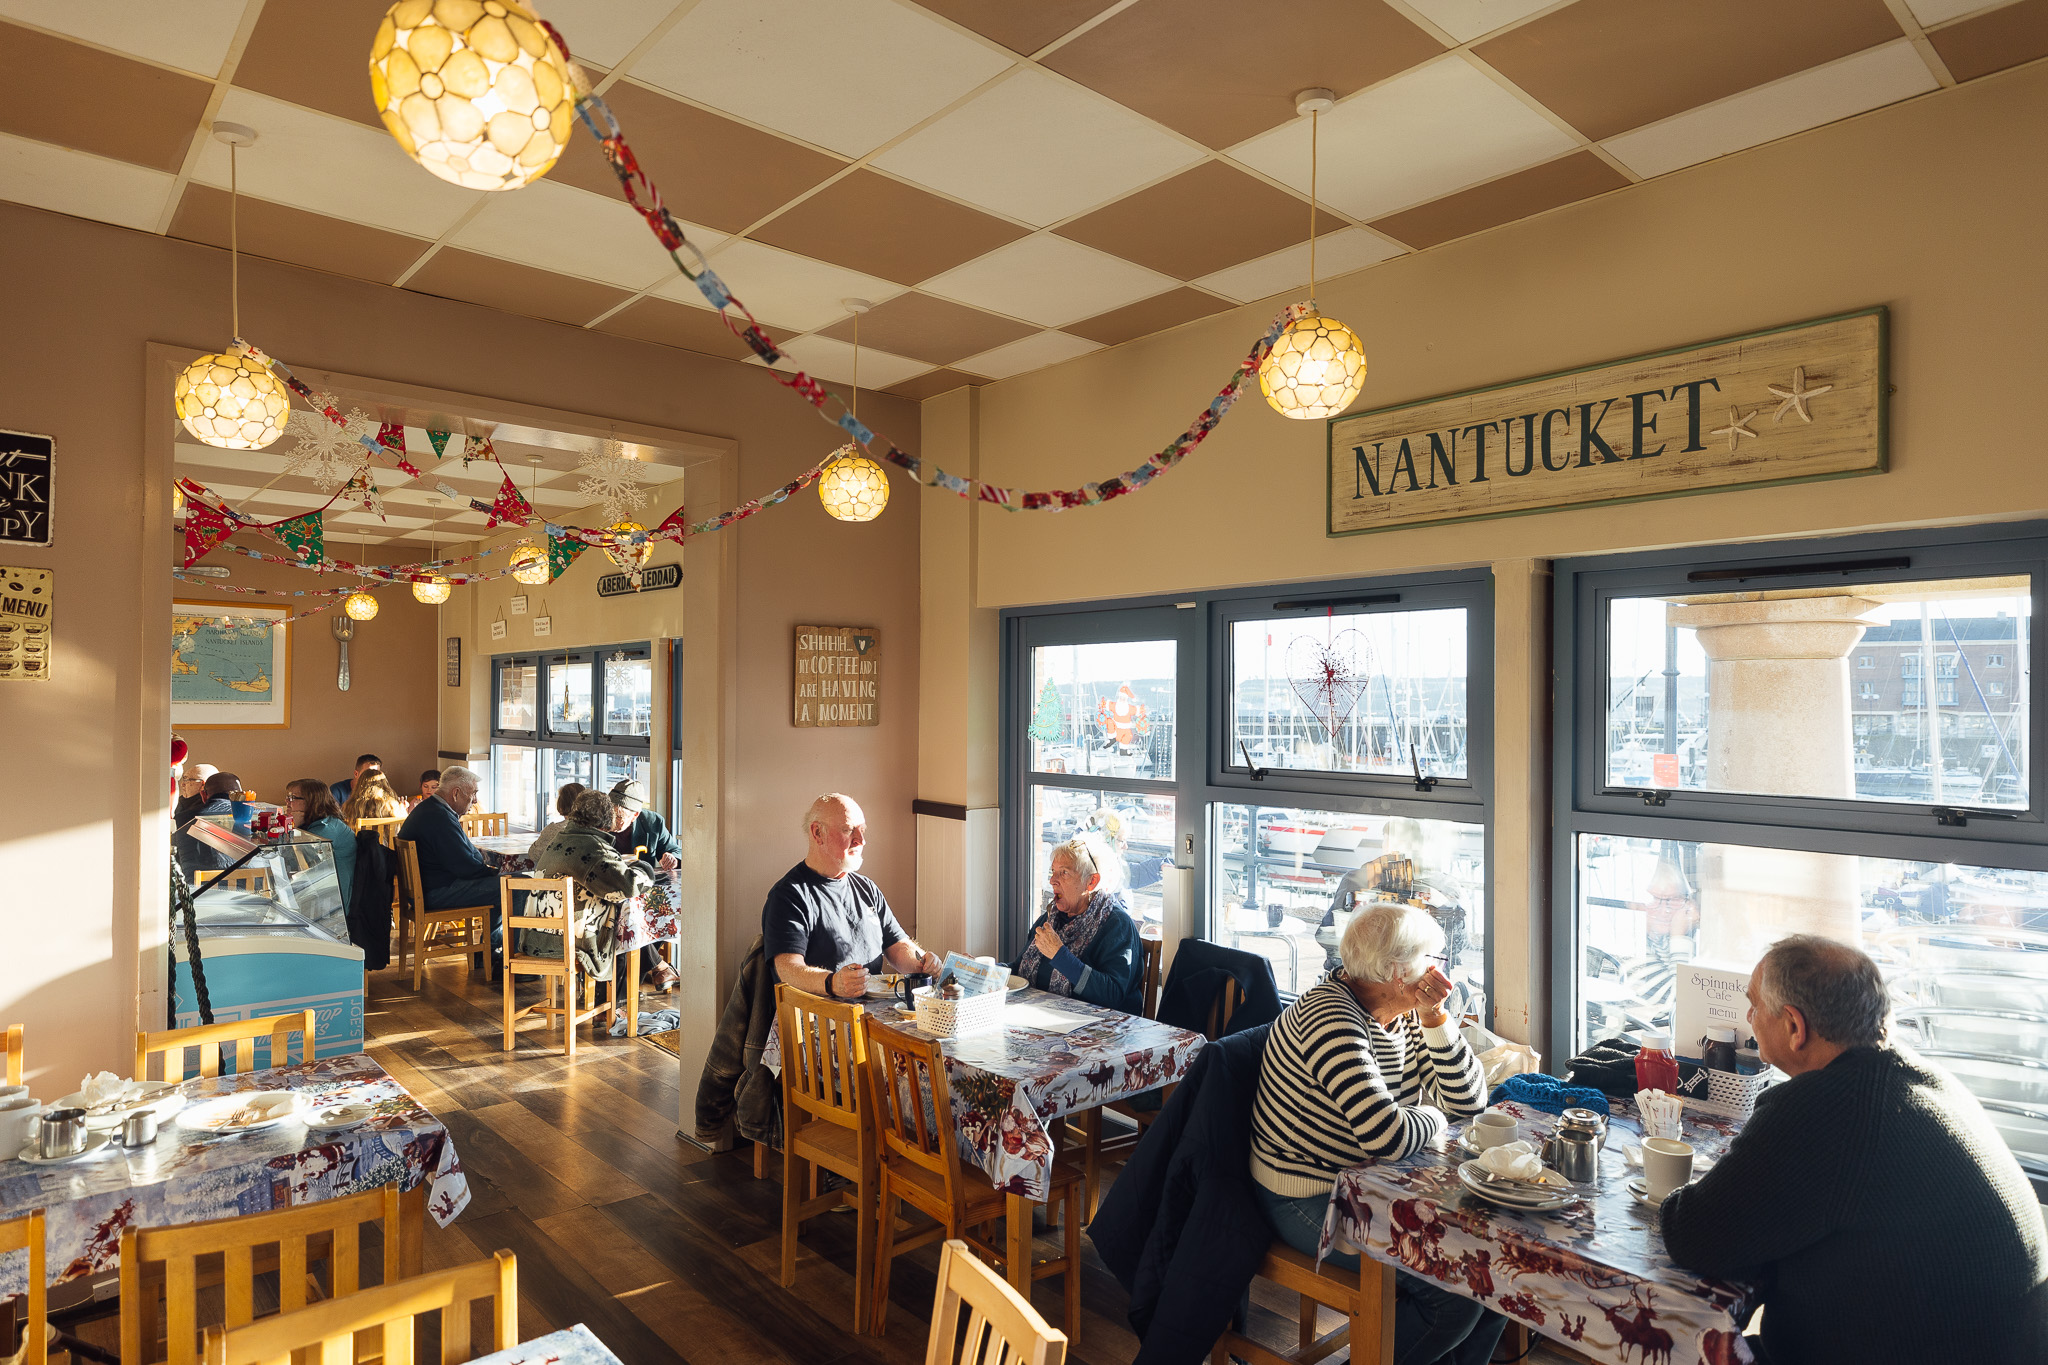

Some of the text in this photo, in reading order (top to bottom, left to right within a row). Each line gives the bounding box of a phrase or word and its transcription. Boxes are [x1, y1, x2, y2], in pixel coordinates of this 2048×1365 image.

[1353, 378, 1721, 499] NANTUCKET
[602, 568, 674, 593] ABERDALEDDAU
[2, 597, 48, 617] MENU
[799, 659, 809, 674] MY
[811, 656, 858, 675] COFFEE
[860, 661, 872, 674] AND
[800, 681, 876, 699] ARE HAVING
[801, 704, 874, 721] A MOMENT
[1691, 973, 1748, 993] Spinnake
[1706, 989, 1732, 1002] Cafe
[350, 999, 362, 1037] JOE'S
[1709, 1007, 1737, 1019] menu
